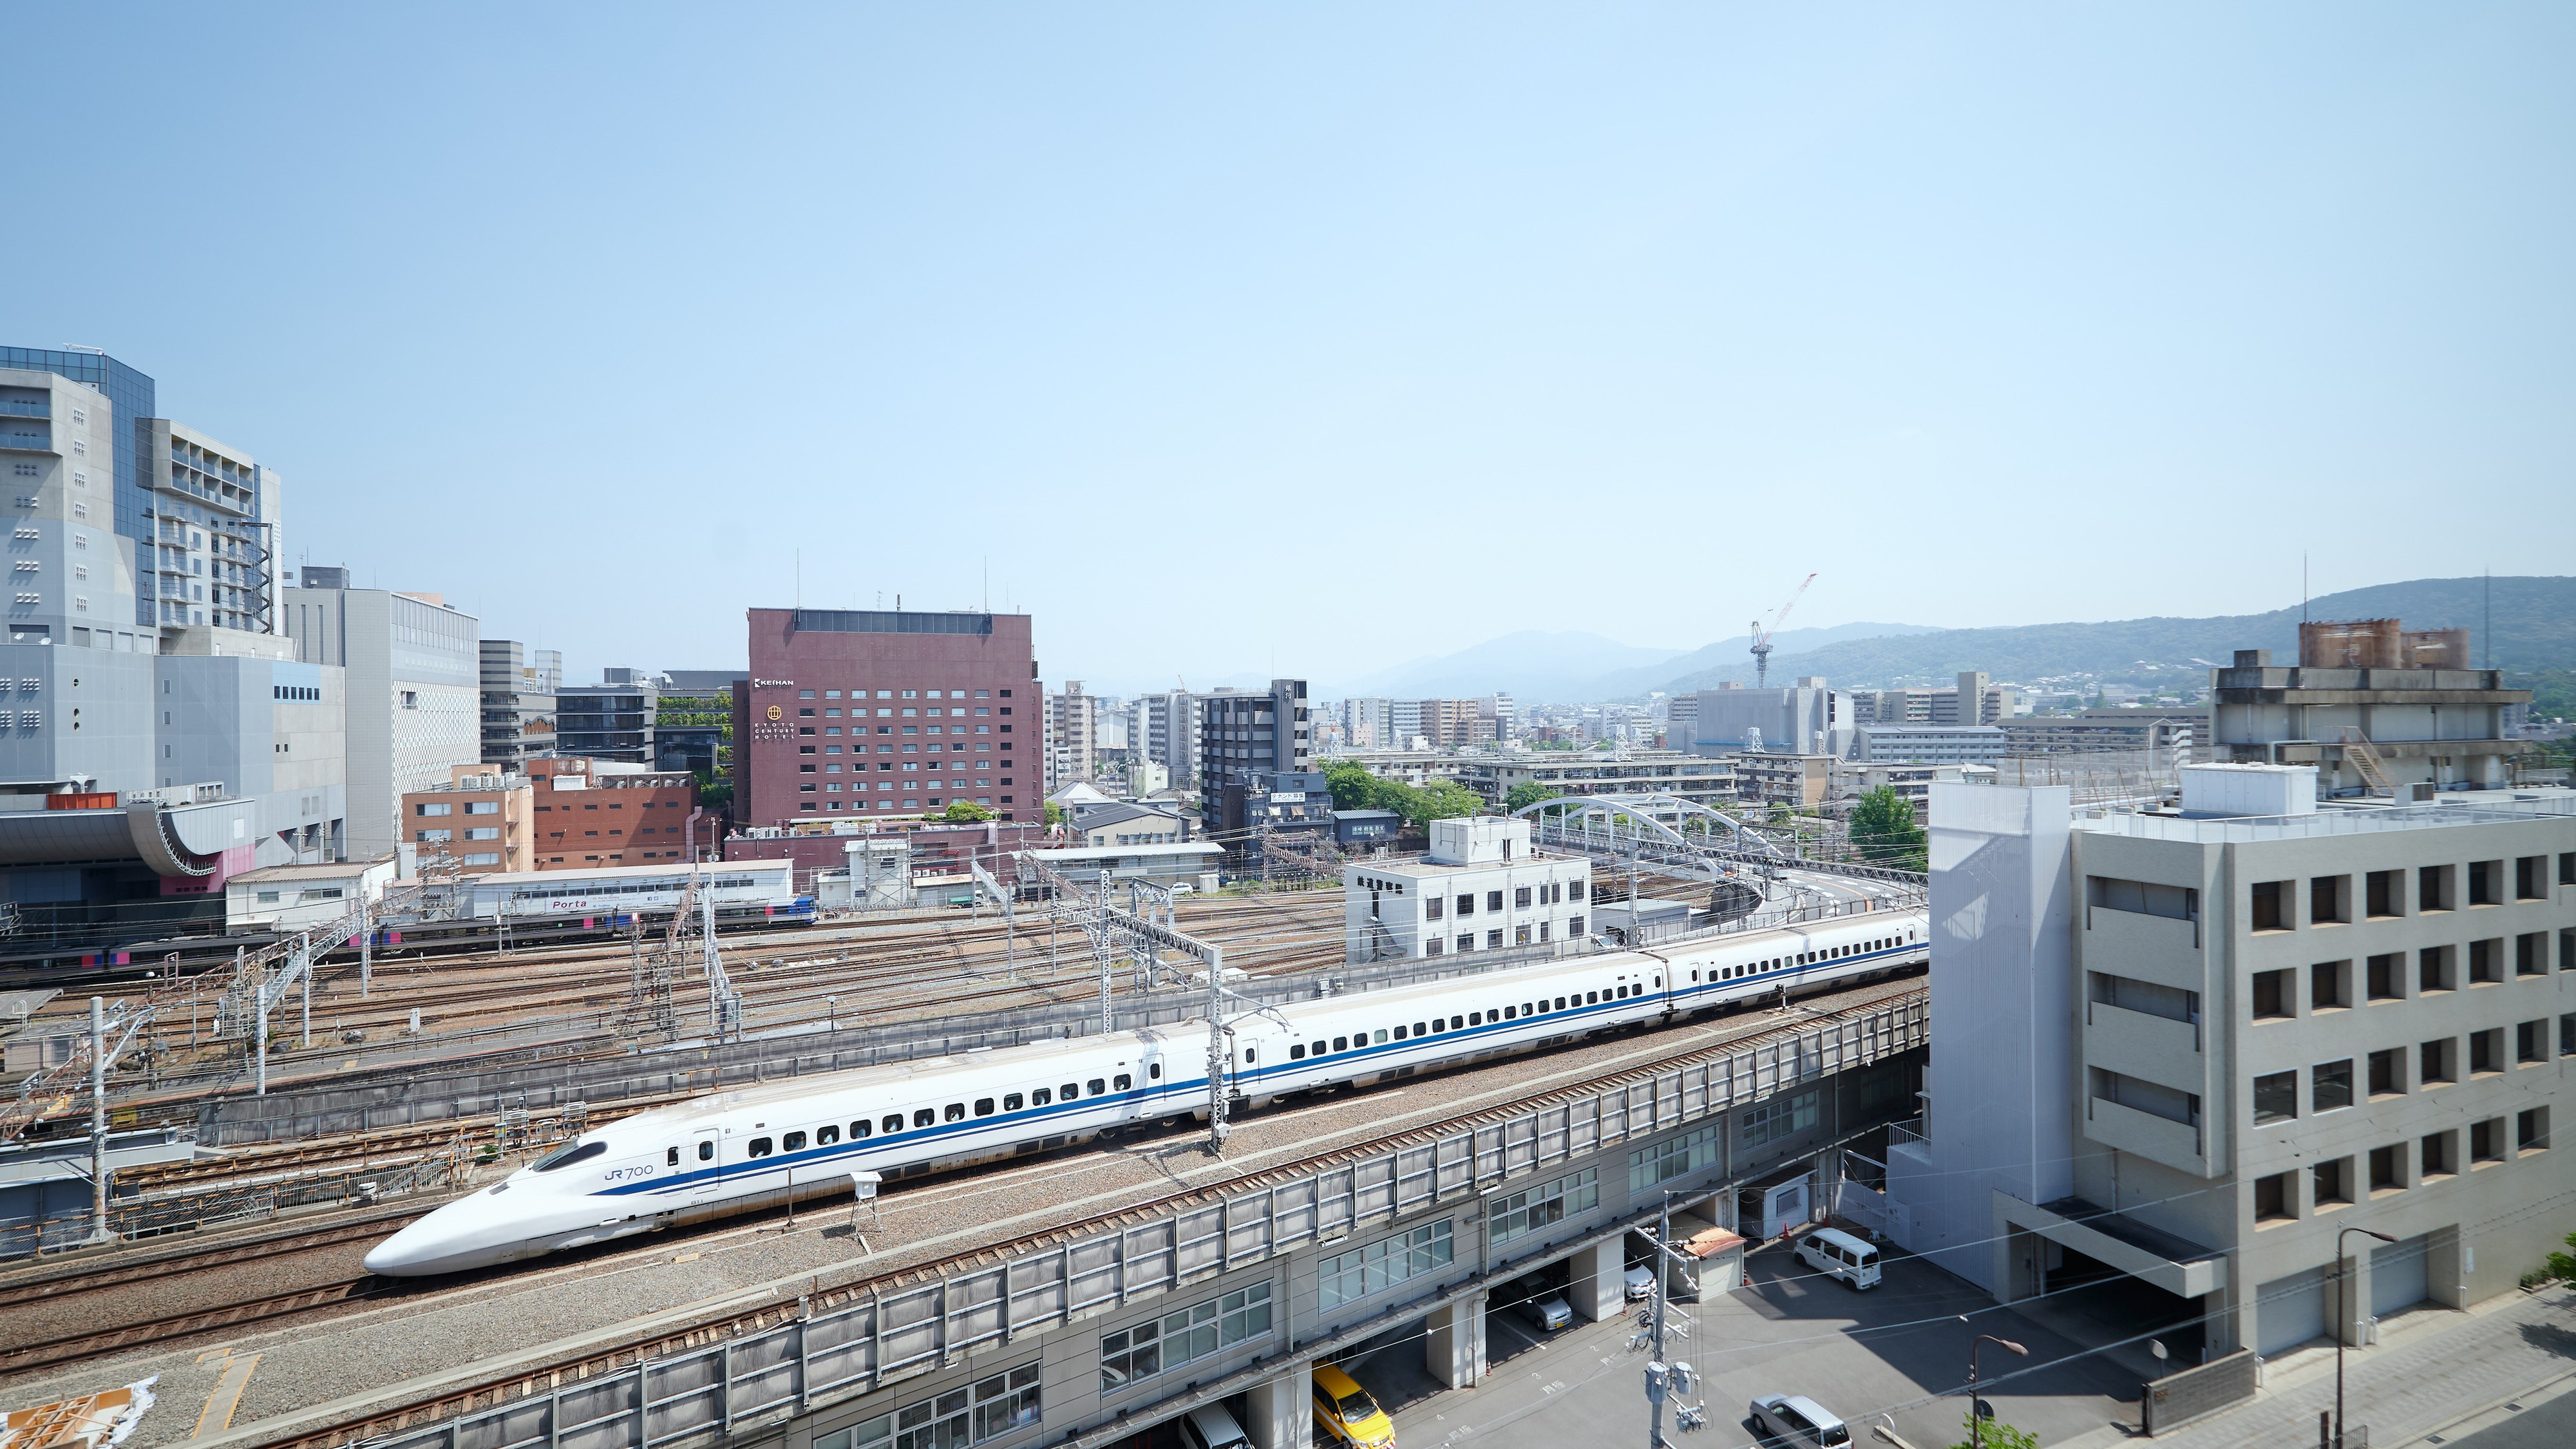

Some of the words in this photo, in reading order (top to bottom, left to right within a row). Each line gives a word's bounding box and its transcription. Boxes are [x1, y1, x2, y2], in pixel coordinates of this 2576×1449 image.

[553, 900, 587, 909] Porta
[605, 1170, 623, 1180] JR
[625, 1165, 654, 1180] 700
